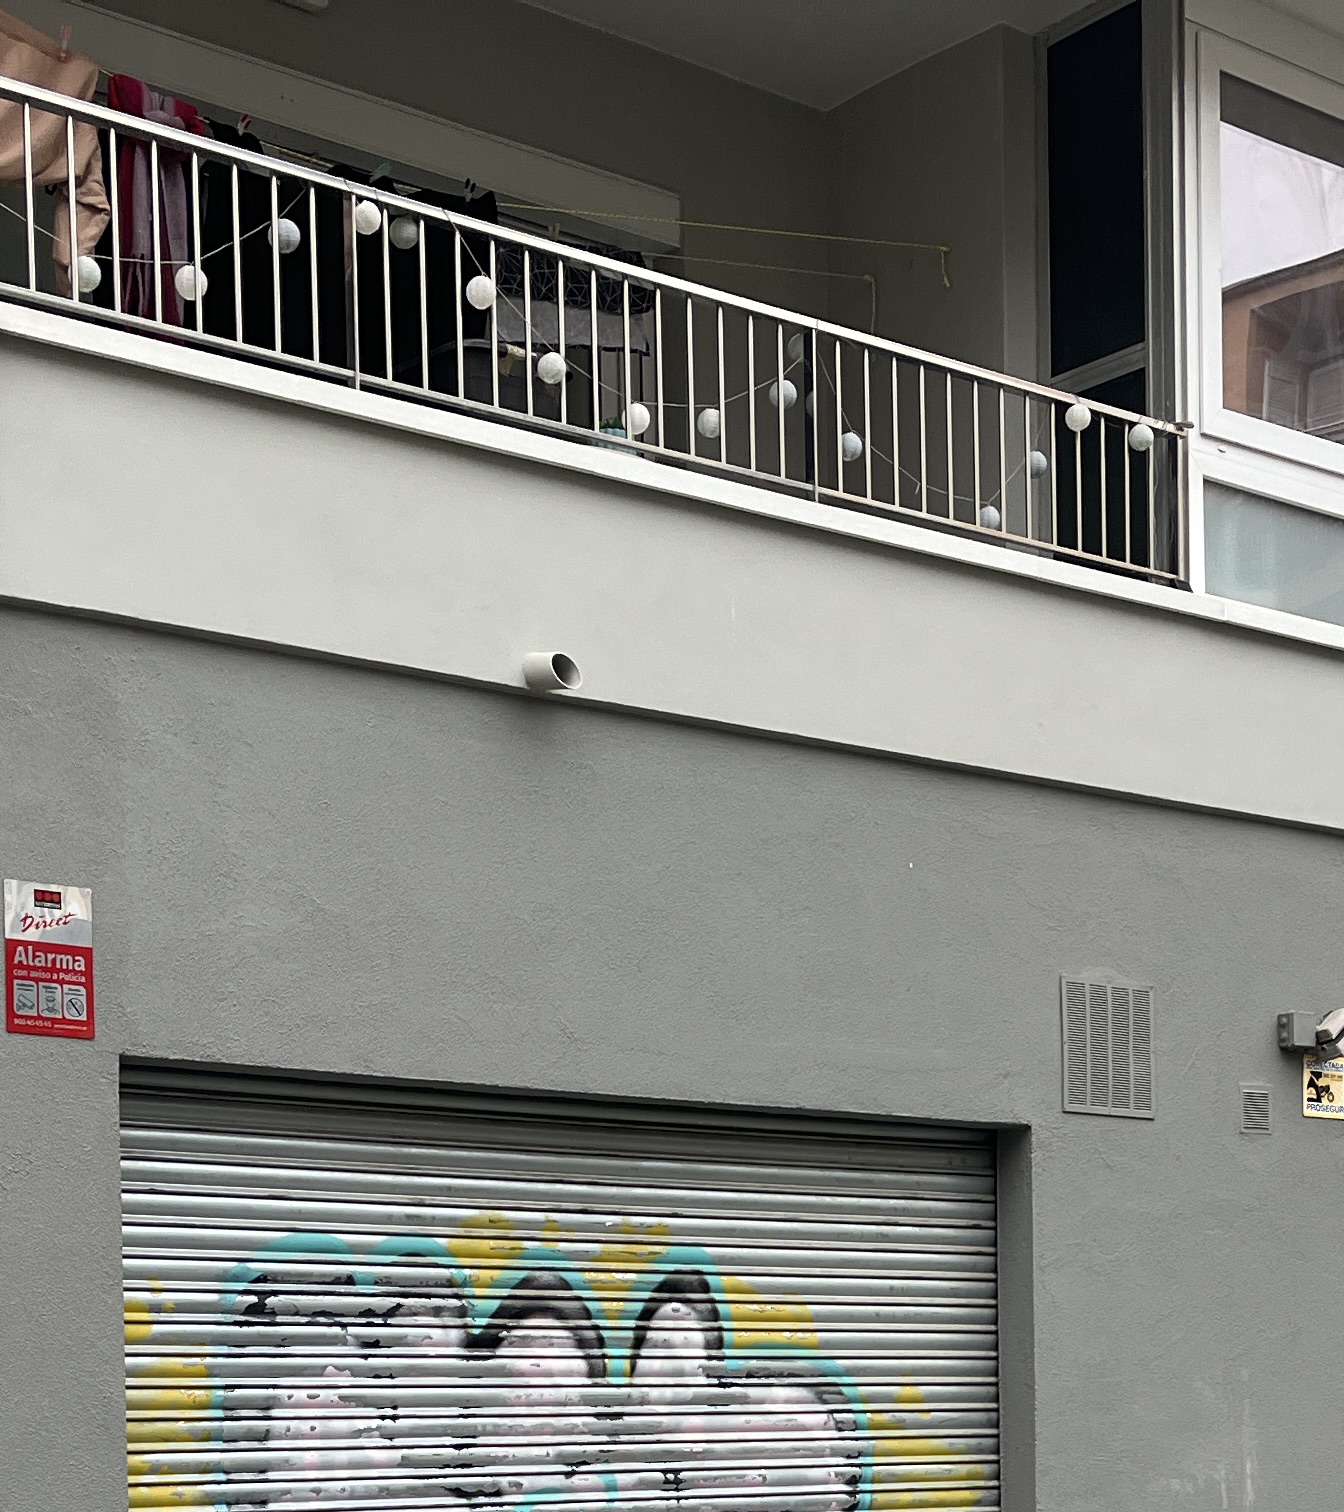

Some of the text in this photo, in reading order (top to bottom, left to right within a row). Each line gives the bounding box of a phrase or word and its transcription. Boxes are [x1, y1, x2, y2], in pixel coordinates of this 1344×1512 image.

[20, 912, 77, 932] Direct
[14, 946, 85, 971] Alarma
[13, 968, 28, 977] con
[1307, 1104, 1344, 1113] PROSEGUR
